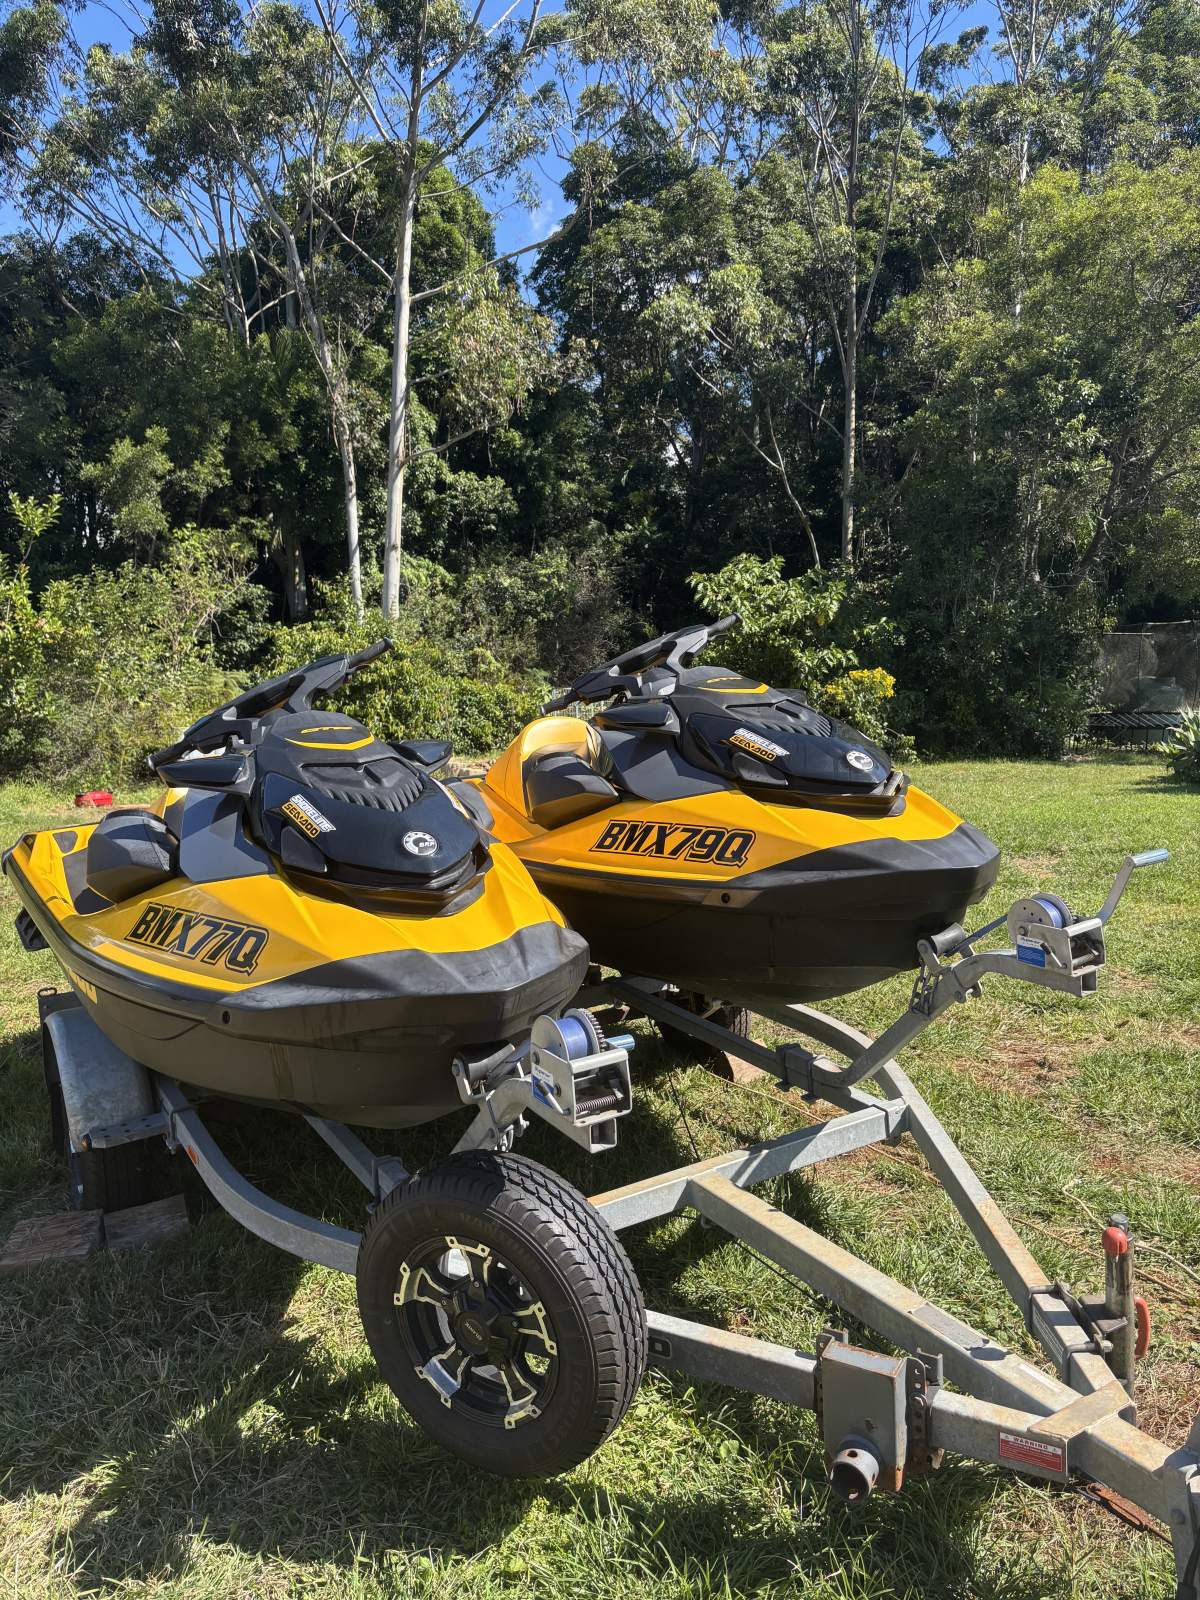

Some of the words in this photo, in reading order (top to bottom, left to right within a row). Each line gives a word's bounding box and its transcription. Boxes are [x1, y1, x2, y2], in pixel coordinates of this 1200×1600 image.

[291, 794, 333, 832] SHORELINE
[589, 819, 757, 868] BMX79Q
[124, 902, 270, 976] BMX77Q
[1013, 1436, 1048, 1450] WARNING
